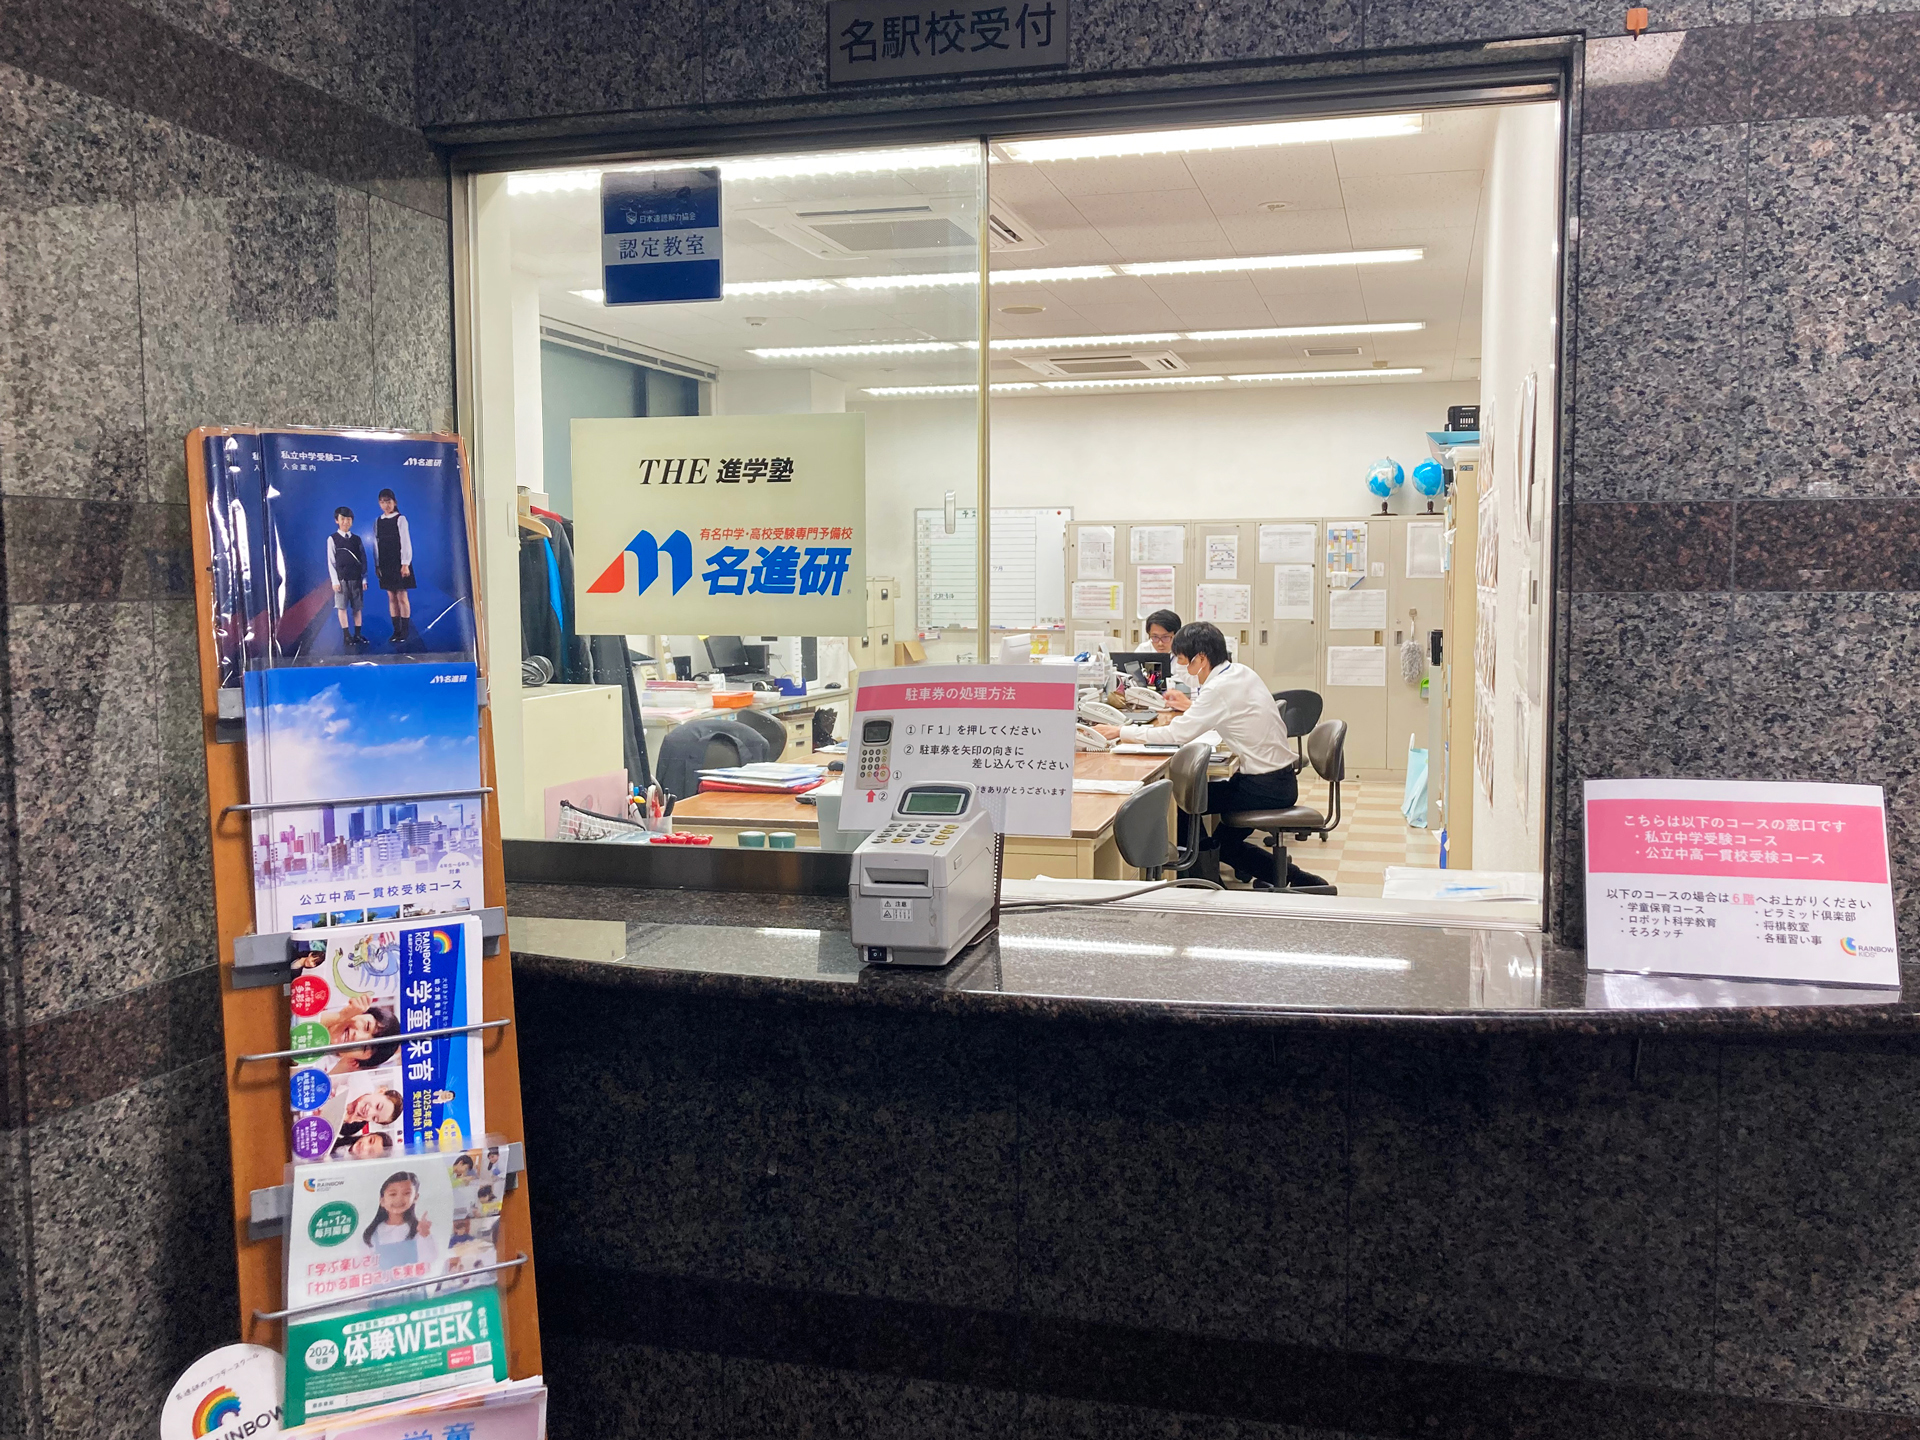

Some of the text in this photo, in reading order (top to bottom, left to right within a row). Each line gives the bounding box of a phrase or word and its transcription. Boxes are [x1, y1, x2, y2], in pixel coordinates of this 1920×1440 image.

[839, 2, 1056, 64] 名駅校受付
[619, 234, 705, 260] 認定教室
[280, 450, 359, 463] 私立中学受験コース
[416, 457, 442, 468] 名進研
[282, 463, 317, 472] 入会案内
[639, 457, 795, 485] THE 進学塾
[699, 527, 853, 542] 有名中学・高校受験専門予備校
[701, 545, 853, 597] 名進研
[442, 674, 468, 684] 名進研
[905, 687, 1016, 701] 駐車券の処理方法
[919, 744, 1025, 757] 駐車券を矢印の向きに
[972, 758, 1069, 771] 差し込んでください
[1624, 815, 1846, 833] こちらは以下のコースの窓口です
[300, 879, 462, 906] 公立中高一貫校受検コース
[423, 931, 431, 973] RAINBOW
[1858, 945, 1894, 953] RAINBOW
[344, 1311, 476, 1367] 体験WEEK
[309, 1345, 336, 1358] 2024
